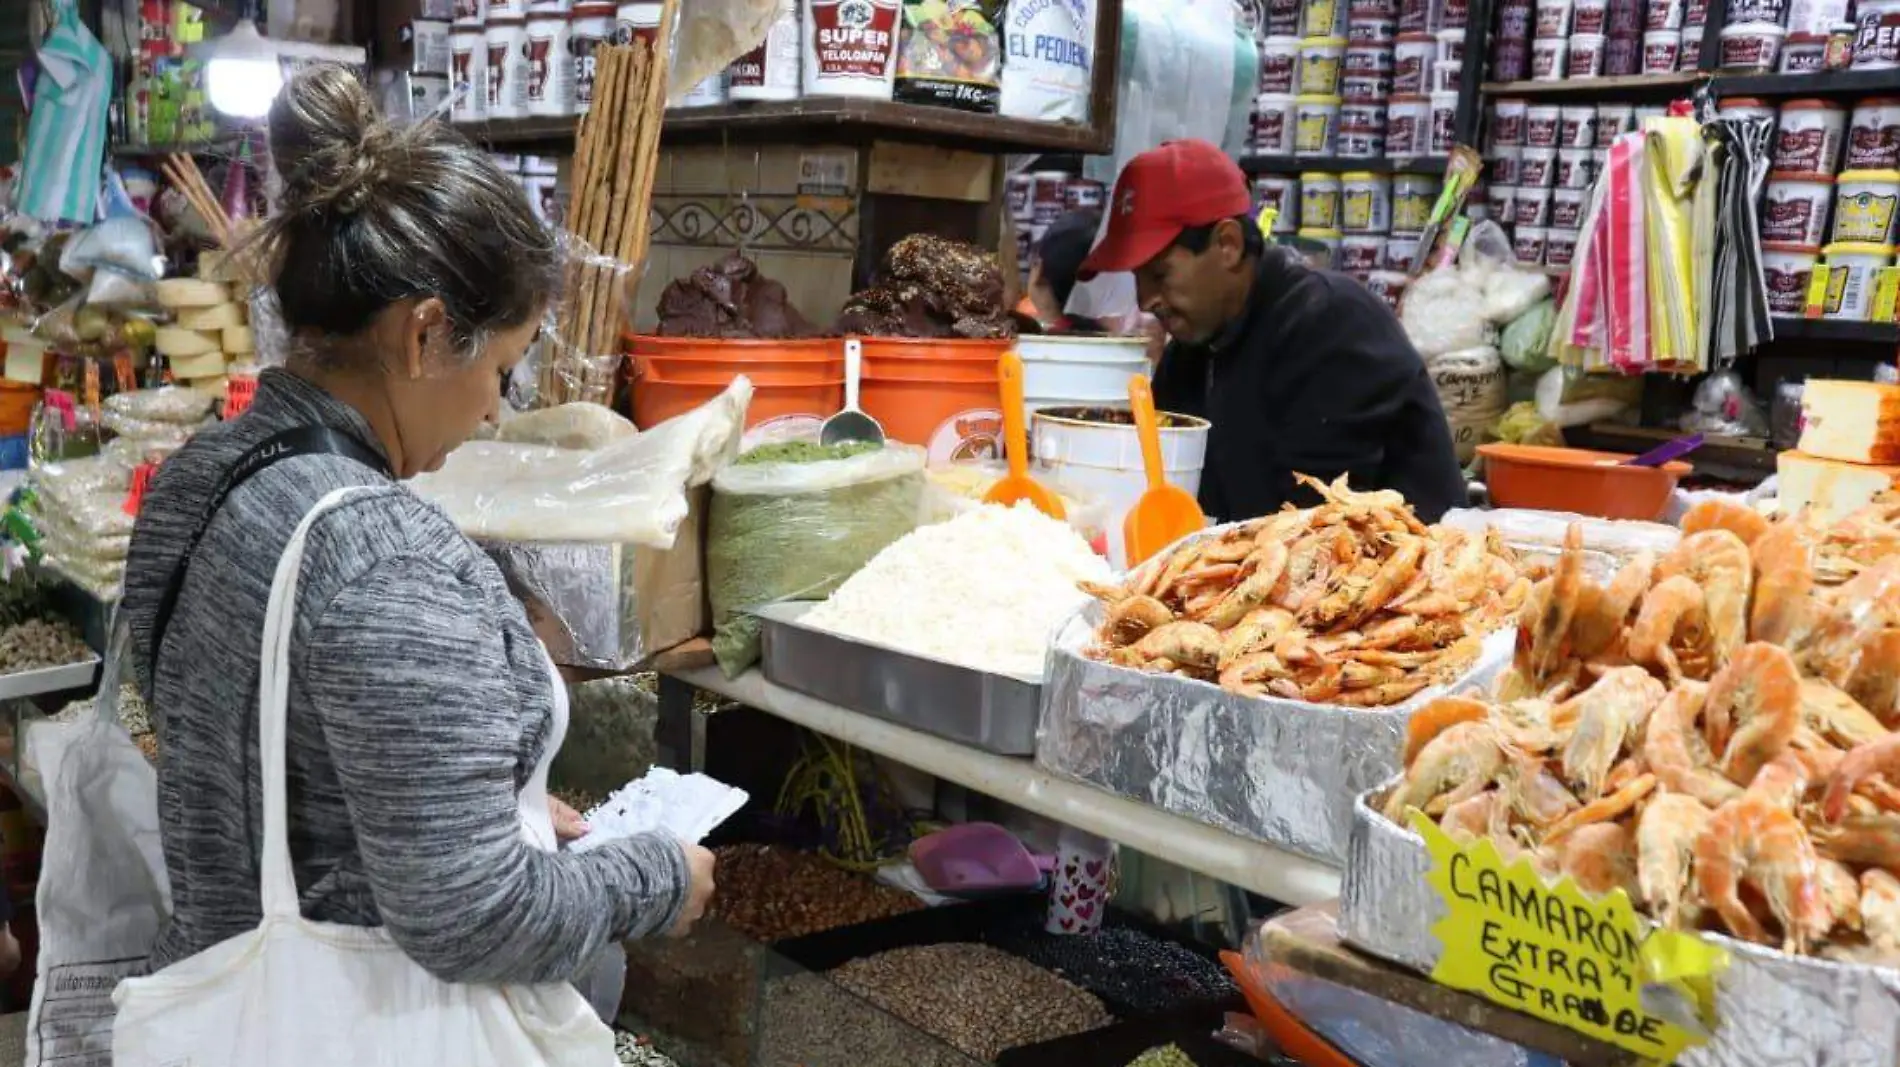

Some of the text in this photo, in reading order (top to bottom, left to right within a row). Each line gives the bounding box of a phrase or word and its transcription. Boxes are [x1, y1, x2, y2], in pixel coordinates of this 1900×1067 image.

[820, 28, 889, 46] SUPER
[1009, 34, 1030, 58] EL
[1451, 852, 1640, 963] CAMARÓN
[1481, 920, 1603, 992] EXTRA
[1489, 963, 1666, 1046] GRADE
